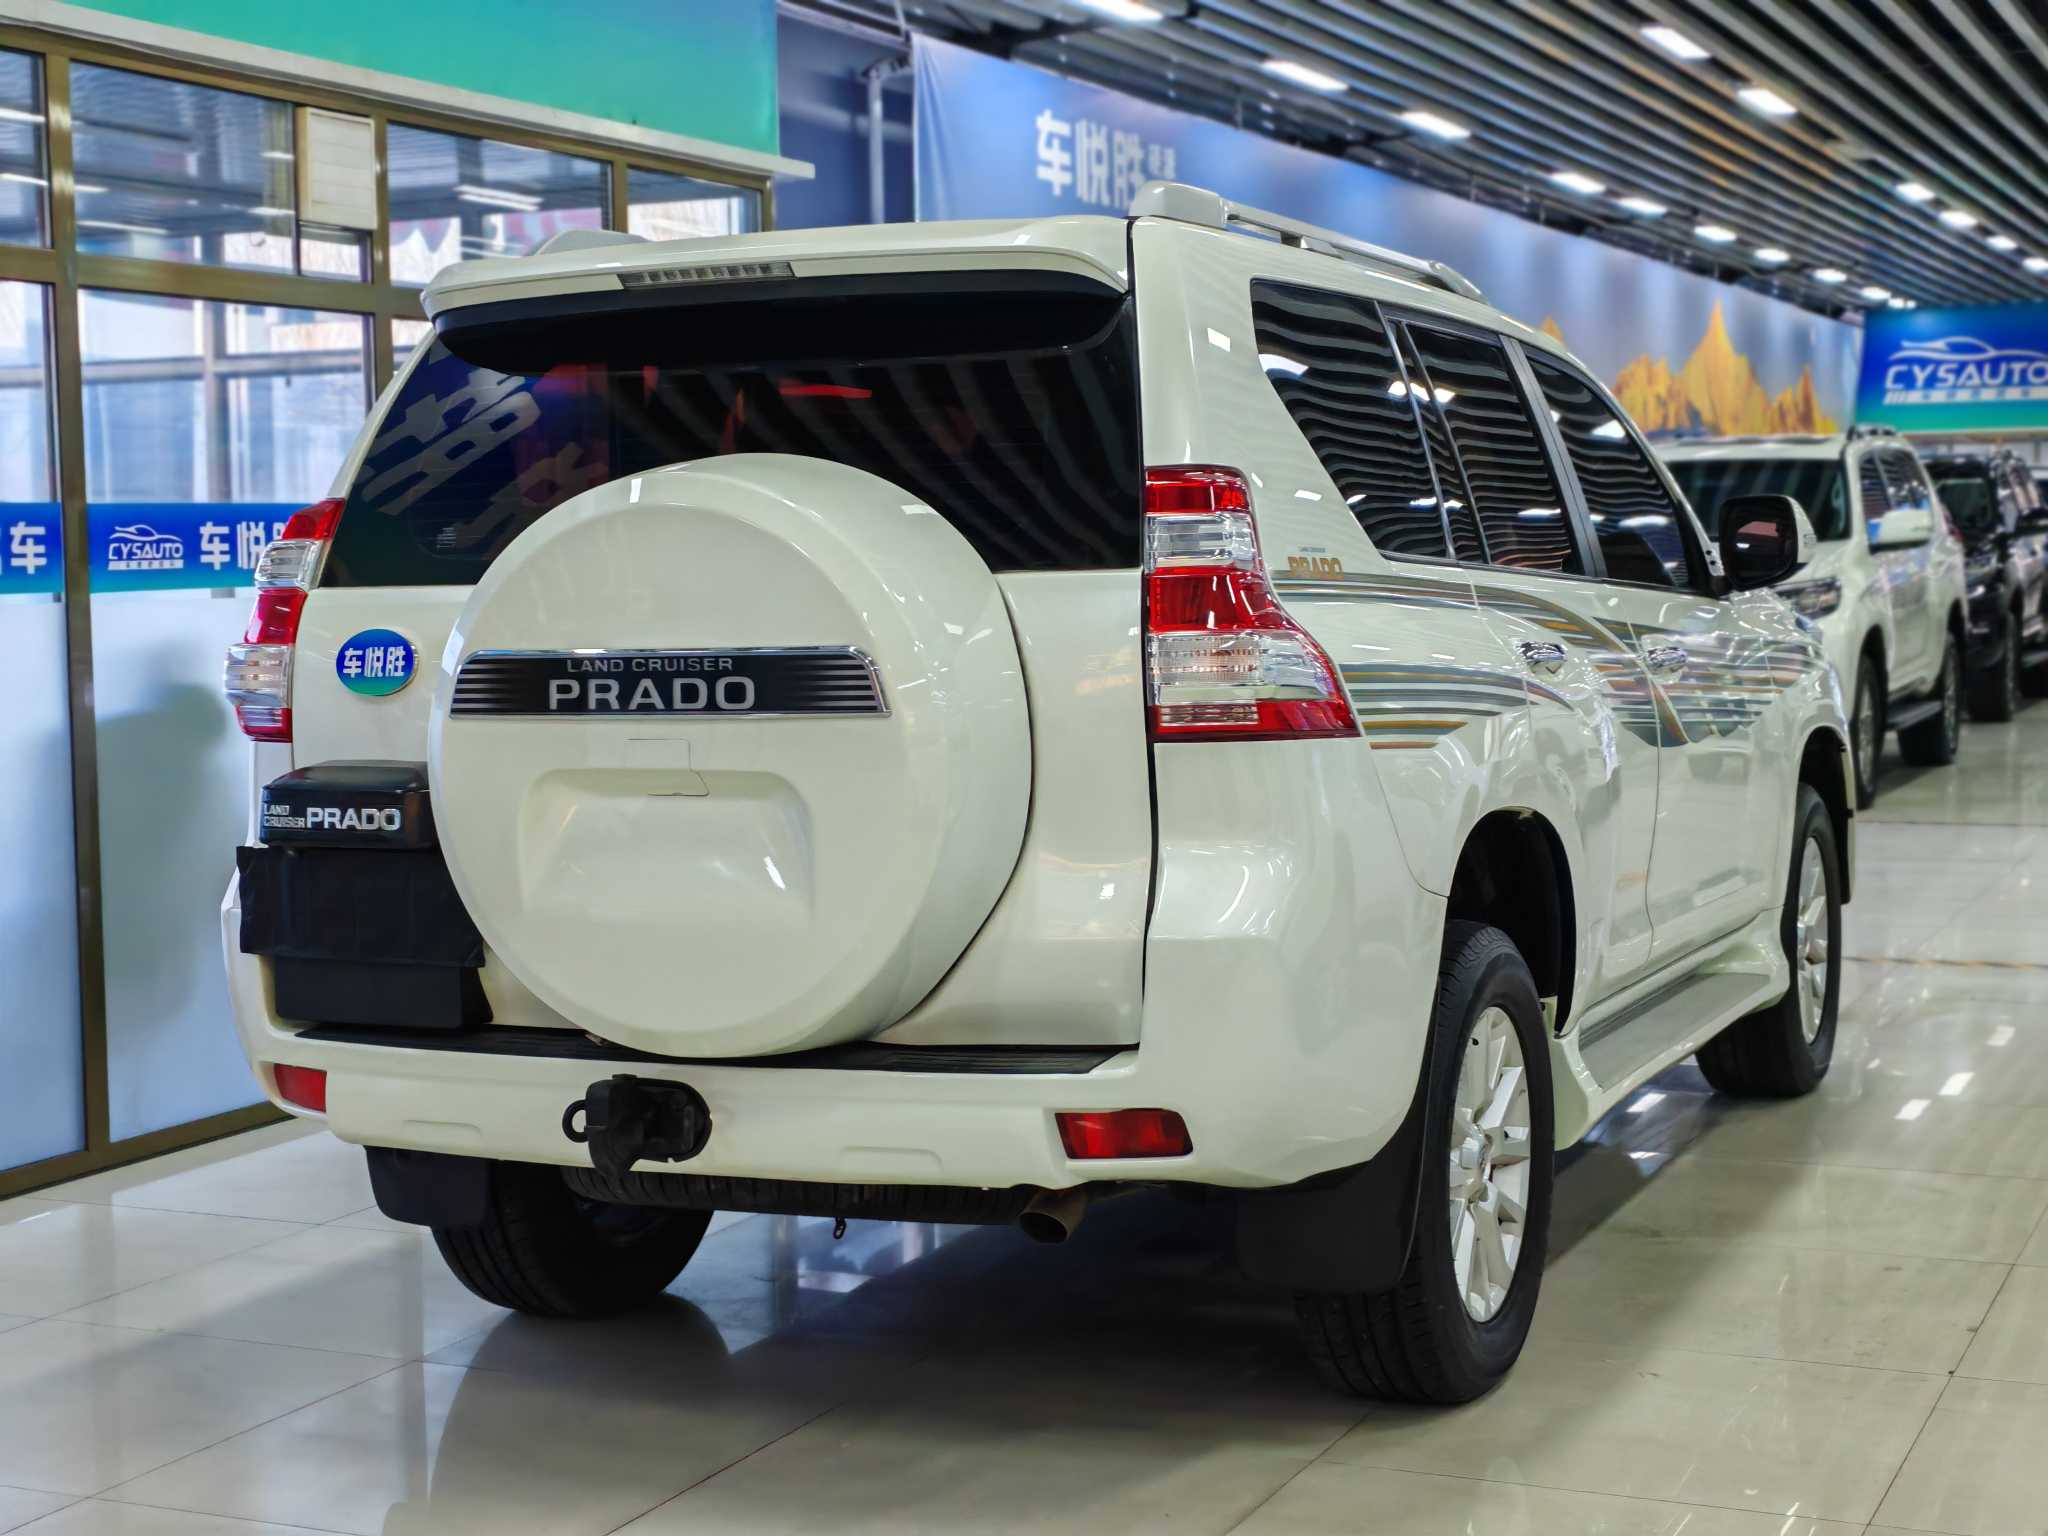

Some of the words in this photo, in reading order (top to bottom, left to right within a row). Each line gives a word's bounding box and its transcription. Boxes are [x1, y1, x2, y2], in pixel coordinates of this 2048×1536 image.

[1885, 361, 2048, 389] CYSAUTO
[108, 543, 184, 560] CYSAUTO
[199, 521, 288, 571] 车悦
[343, 646, 406, 678] 车悦胜
[567, 658, 625, 673] LAND
[631, 657, 733, 672] CRUISER
[549, 676, 756, 711] PRADO
[263, 803, 290, 816] LAND
[306, 807, 401, 831] PRADO
[263, 816, 306, 829] CRUISER
